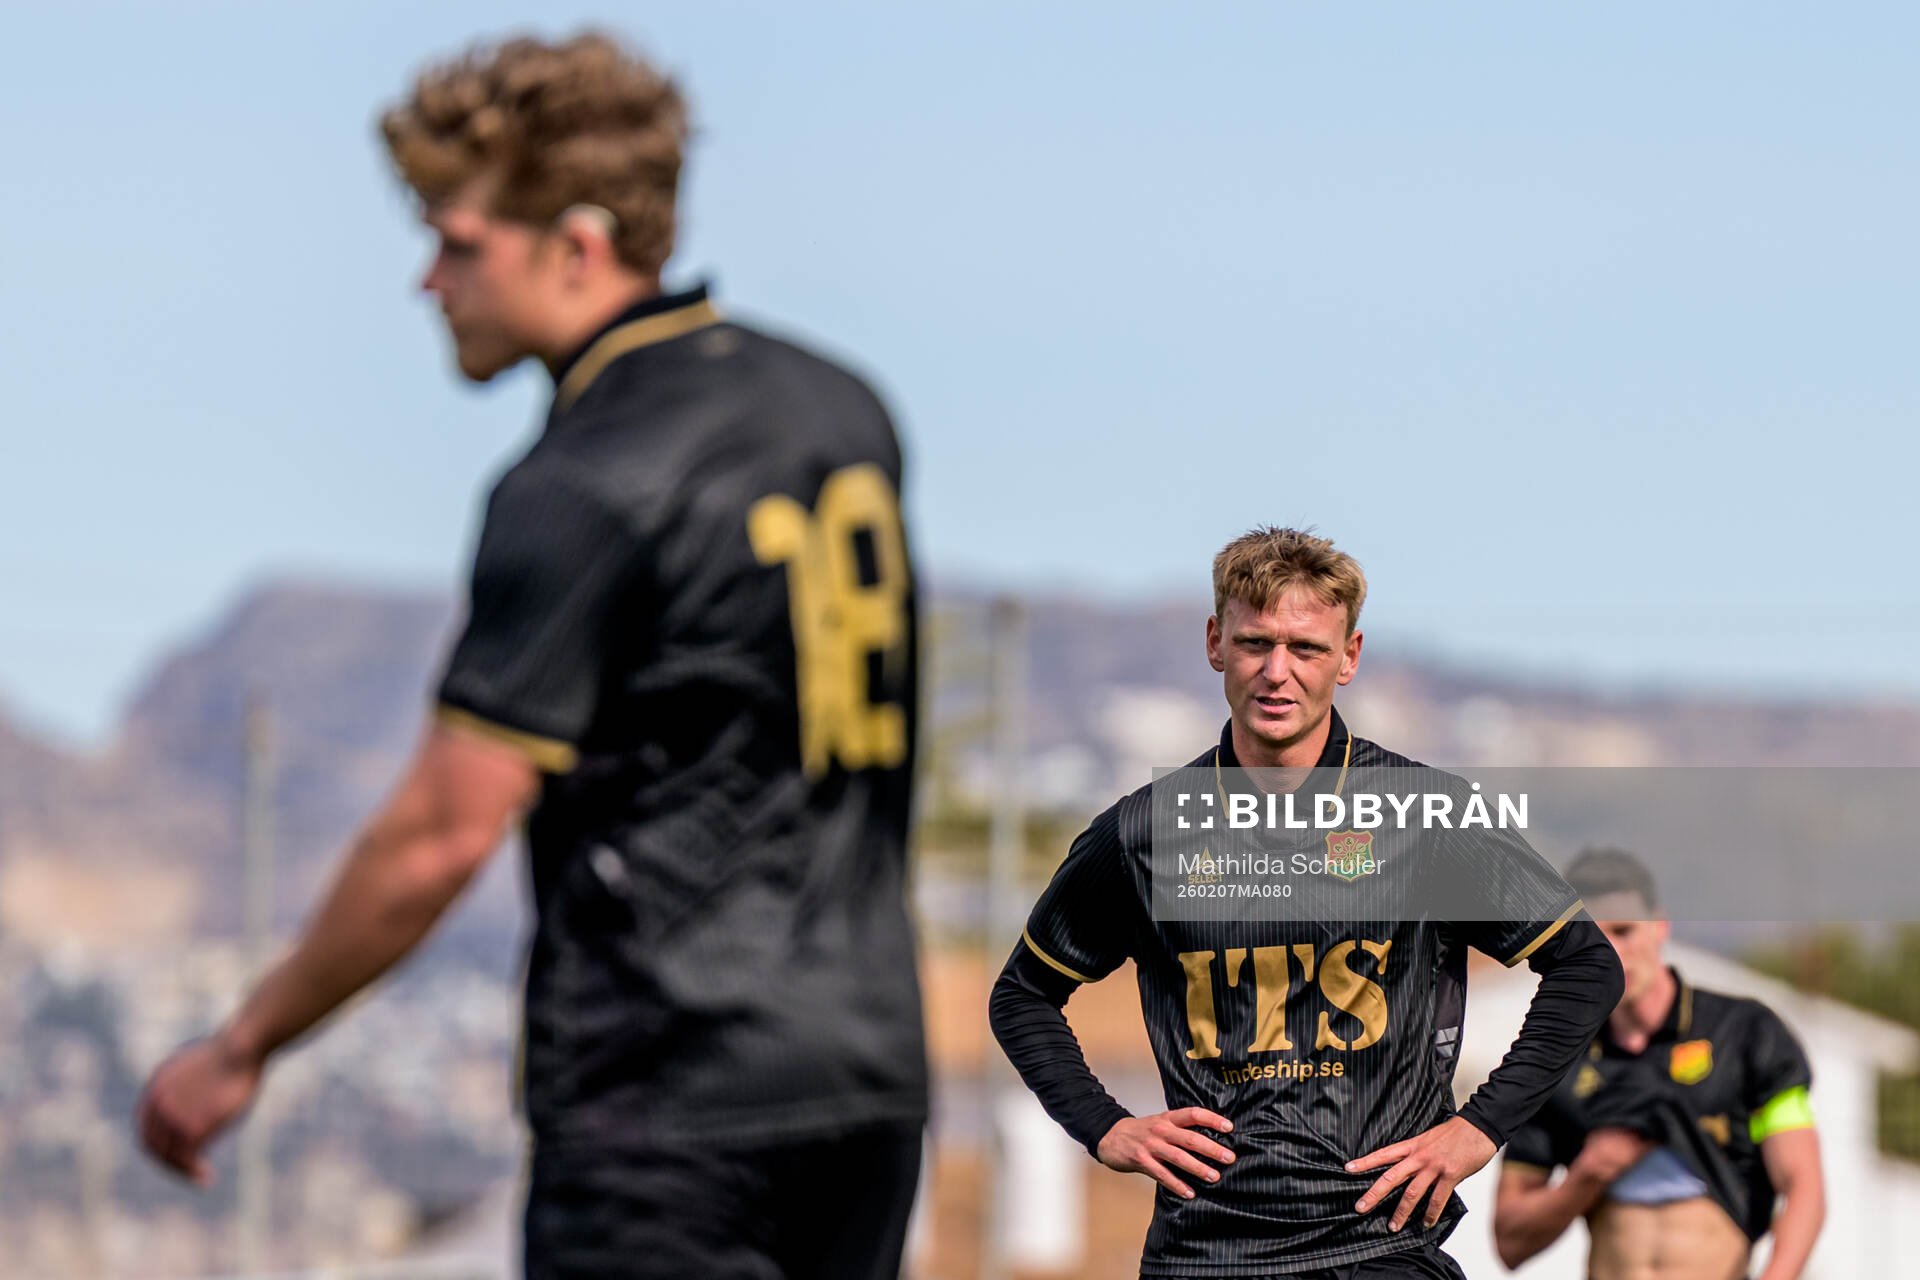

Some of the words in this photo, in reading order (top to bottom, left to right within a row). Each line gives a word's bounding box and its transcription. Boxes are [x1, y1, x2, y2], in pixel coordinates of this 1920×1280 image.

[1188, 872, 1222, 884] SELECT
[1178, 939, 1392, 1060] ITS
[1221, 1059, 1344, 1085] indeship.se
